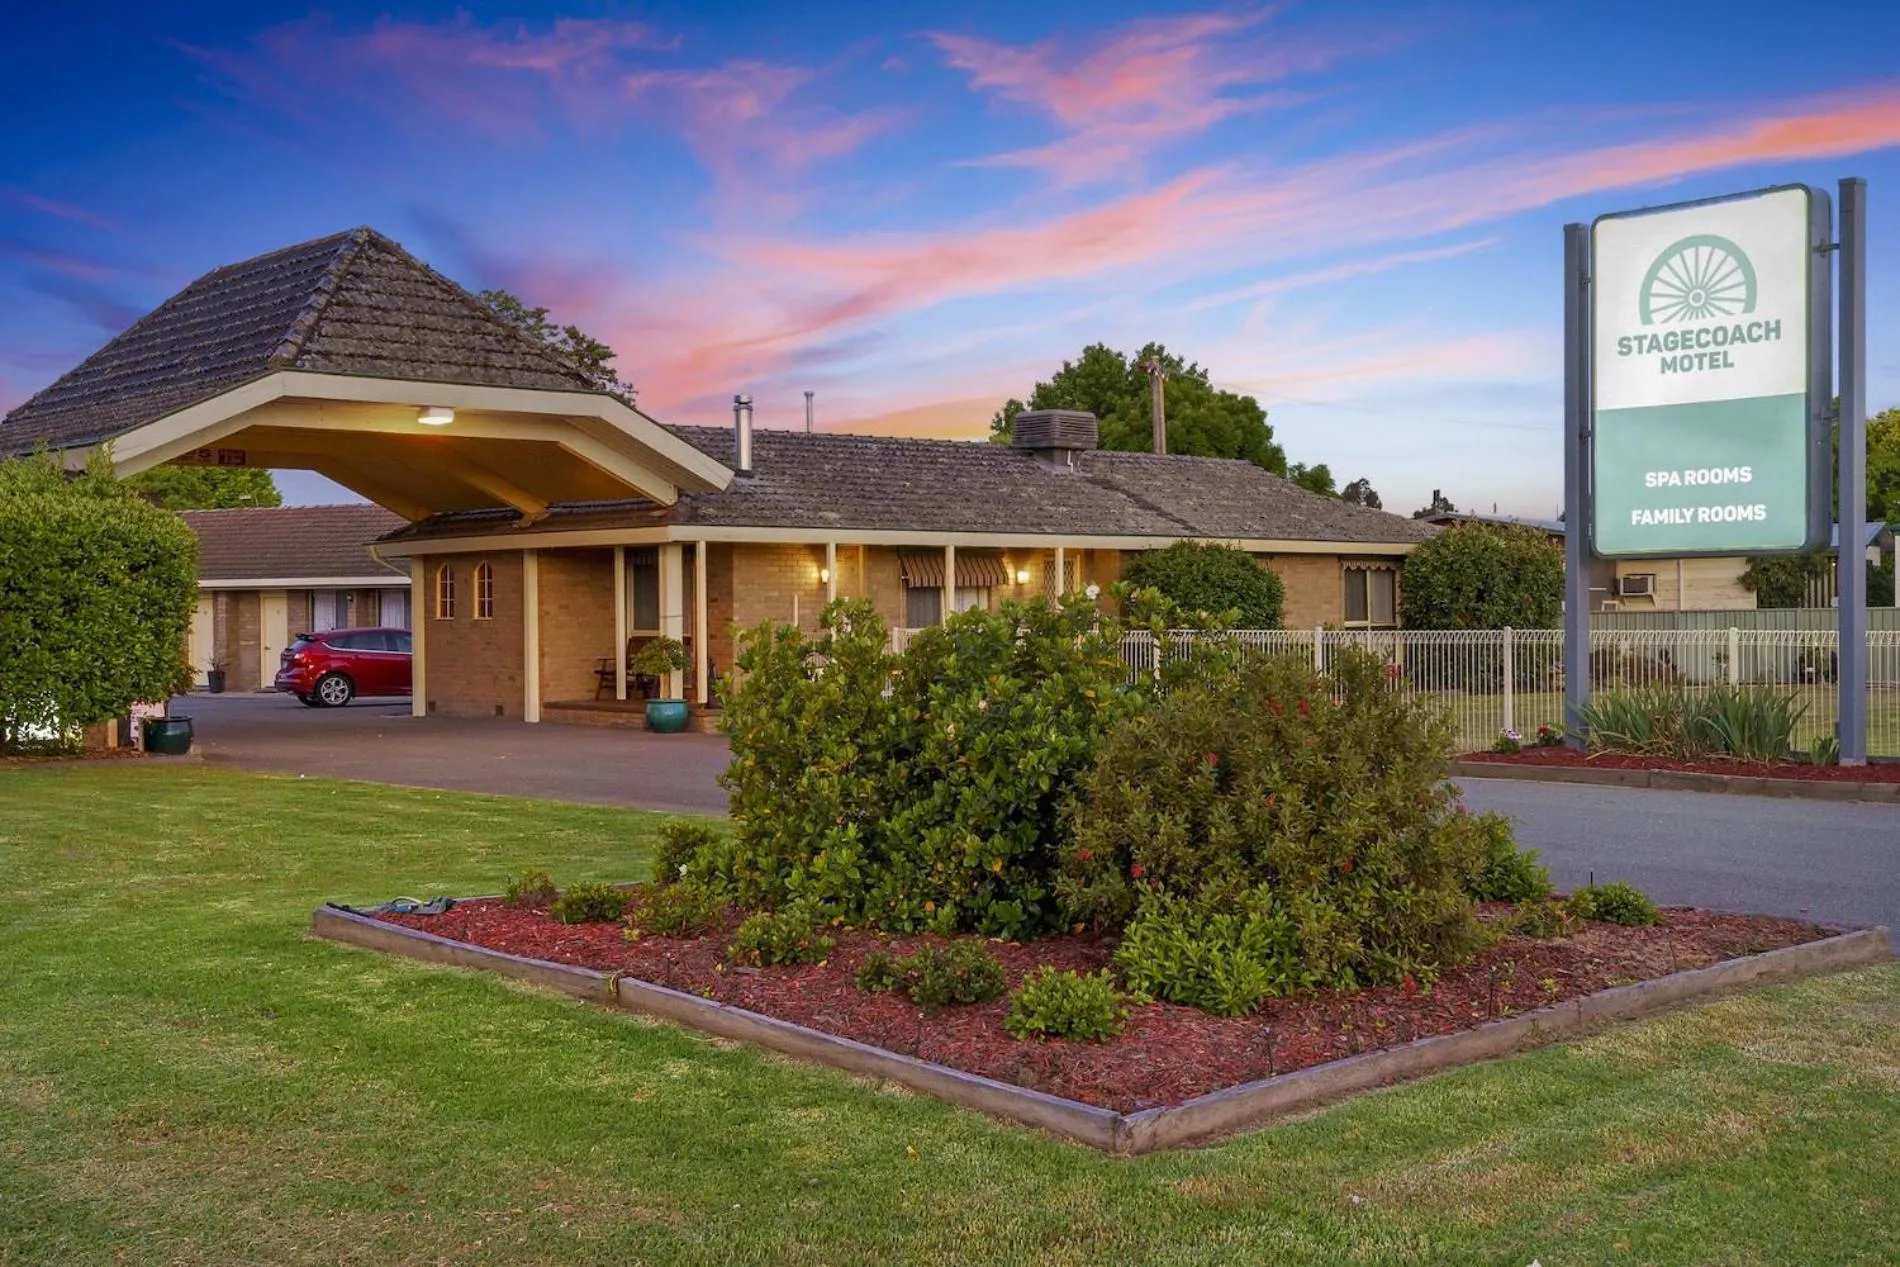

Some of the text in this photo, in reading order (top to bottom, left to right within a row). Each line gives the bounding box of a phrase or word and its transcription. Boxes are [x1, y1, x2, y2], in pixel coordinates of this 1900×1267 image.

[1617, 319, 1782, 357] STAGECOACH
[1660, 350, 1735, 375] MOTEL
[1645, 465, 1753, 488] SPA ROOMS
[1631, 503, 1767, 526] FAMILY ROOMS
